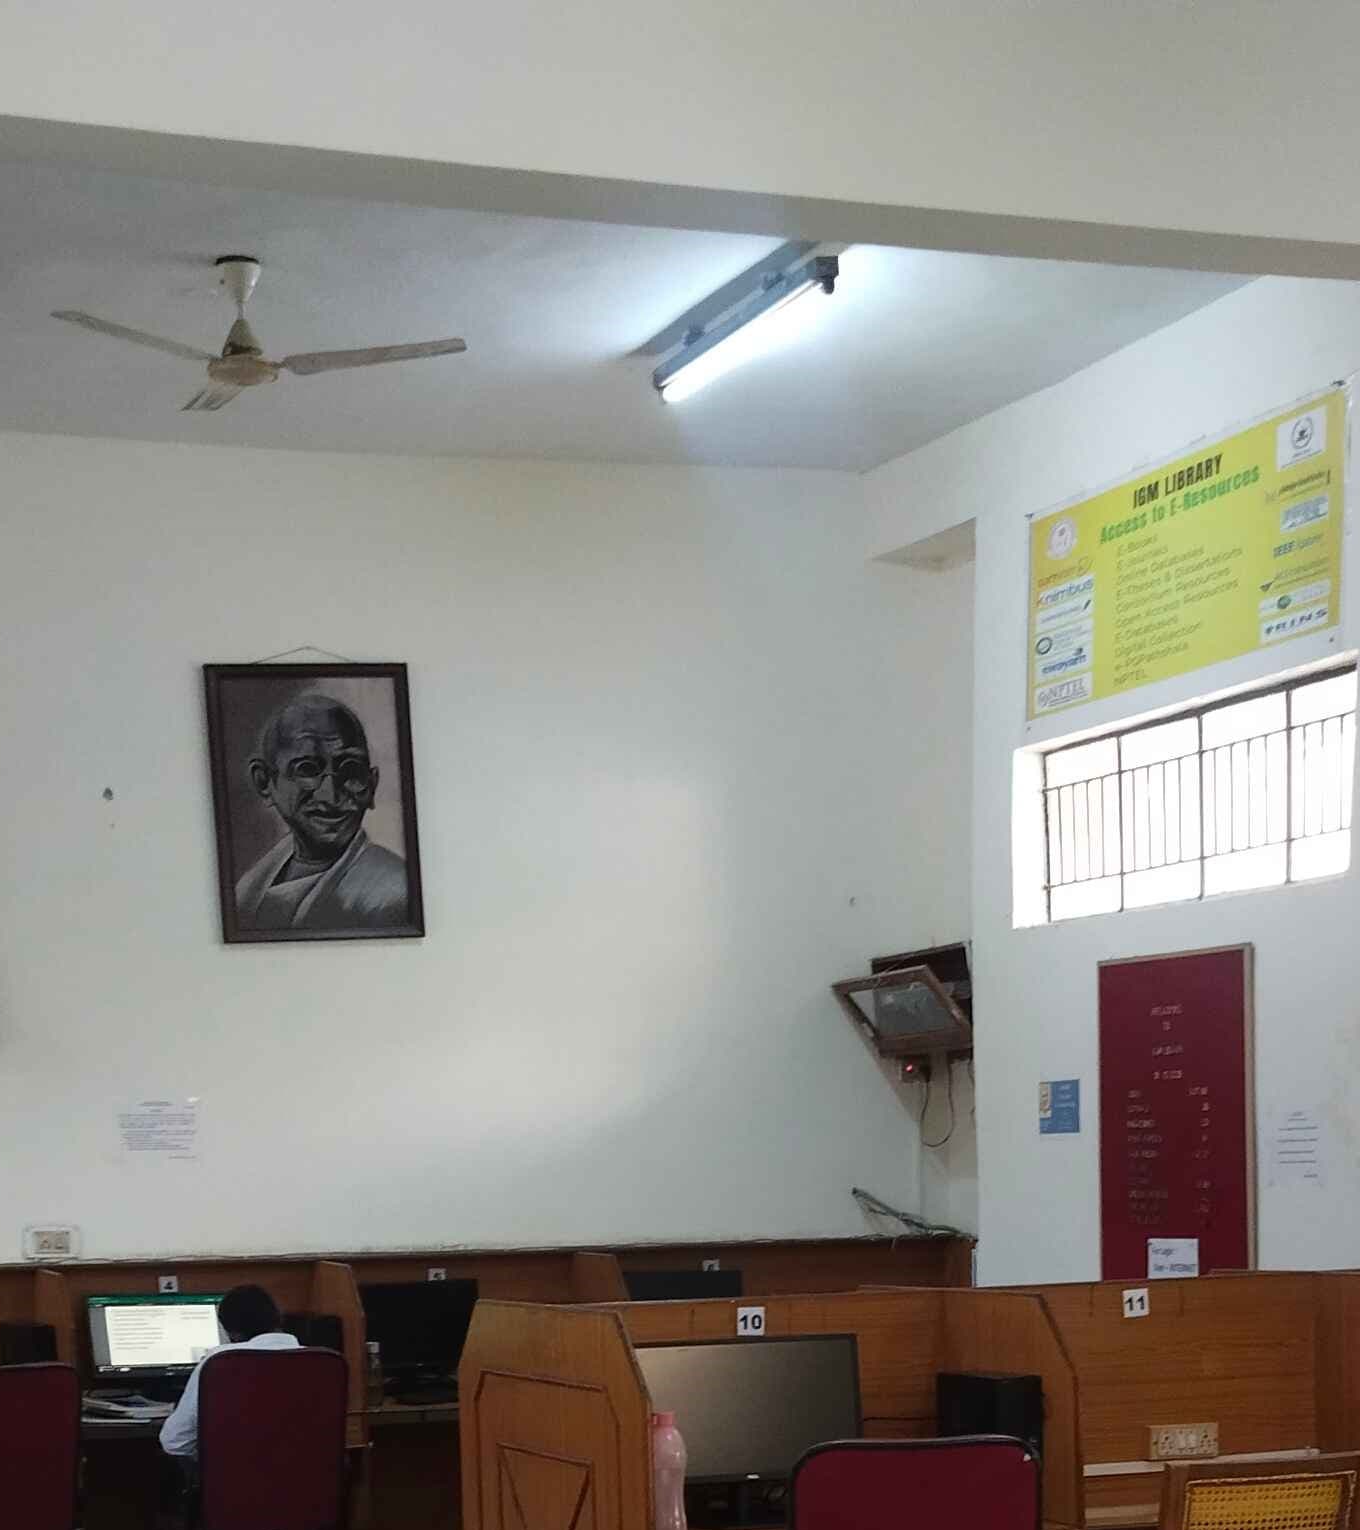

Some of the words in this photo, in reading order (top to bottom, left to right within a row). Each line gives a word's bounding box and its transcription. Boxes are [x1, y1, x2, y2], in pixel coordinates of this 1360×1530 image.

[1133, 481, 1159, 509] IGM
[1165, 453, 1223, 496] LIBRARY
[1100, 512, 1147, 544] Access
[1153, 505, 1165, 523] to
[1170, 465, 1260, 516] E-Resources
[1124, 1296, 1144, 1311] 11
[739, 1314, 763, 1330] 10
